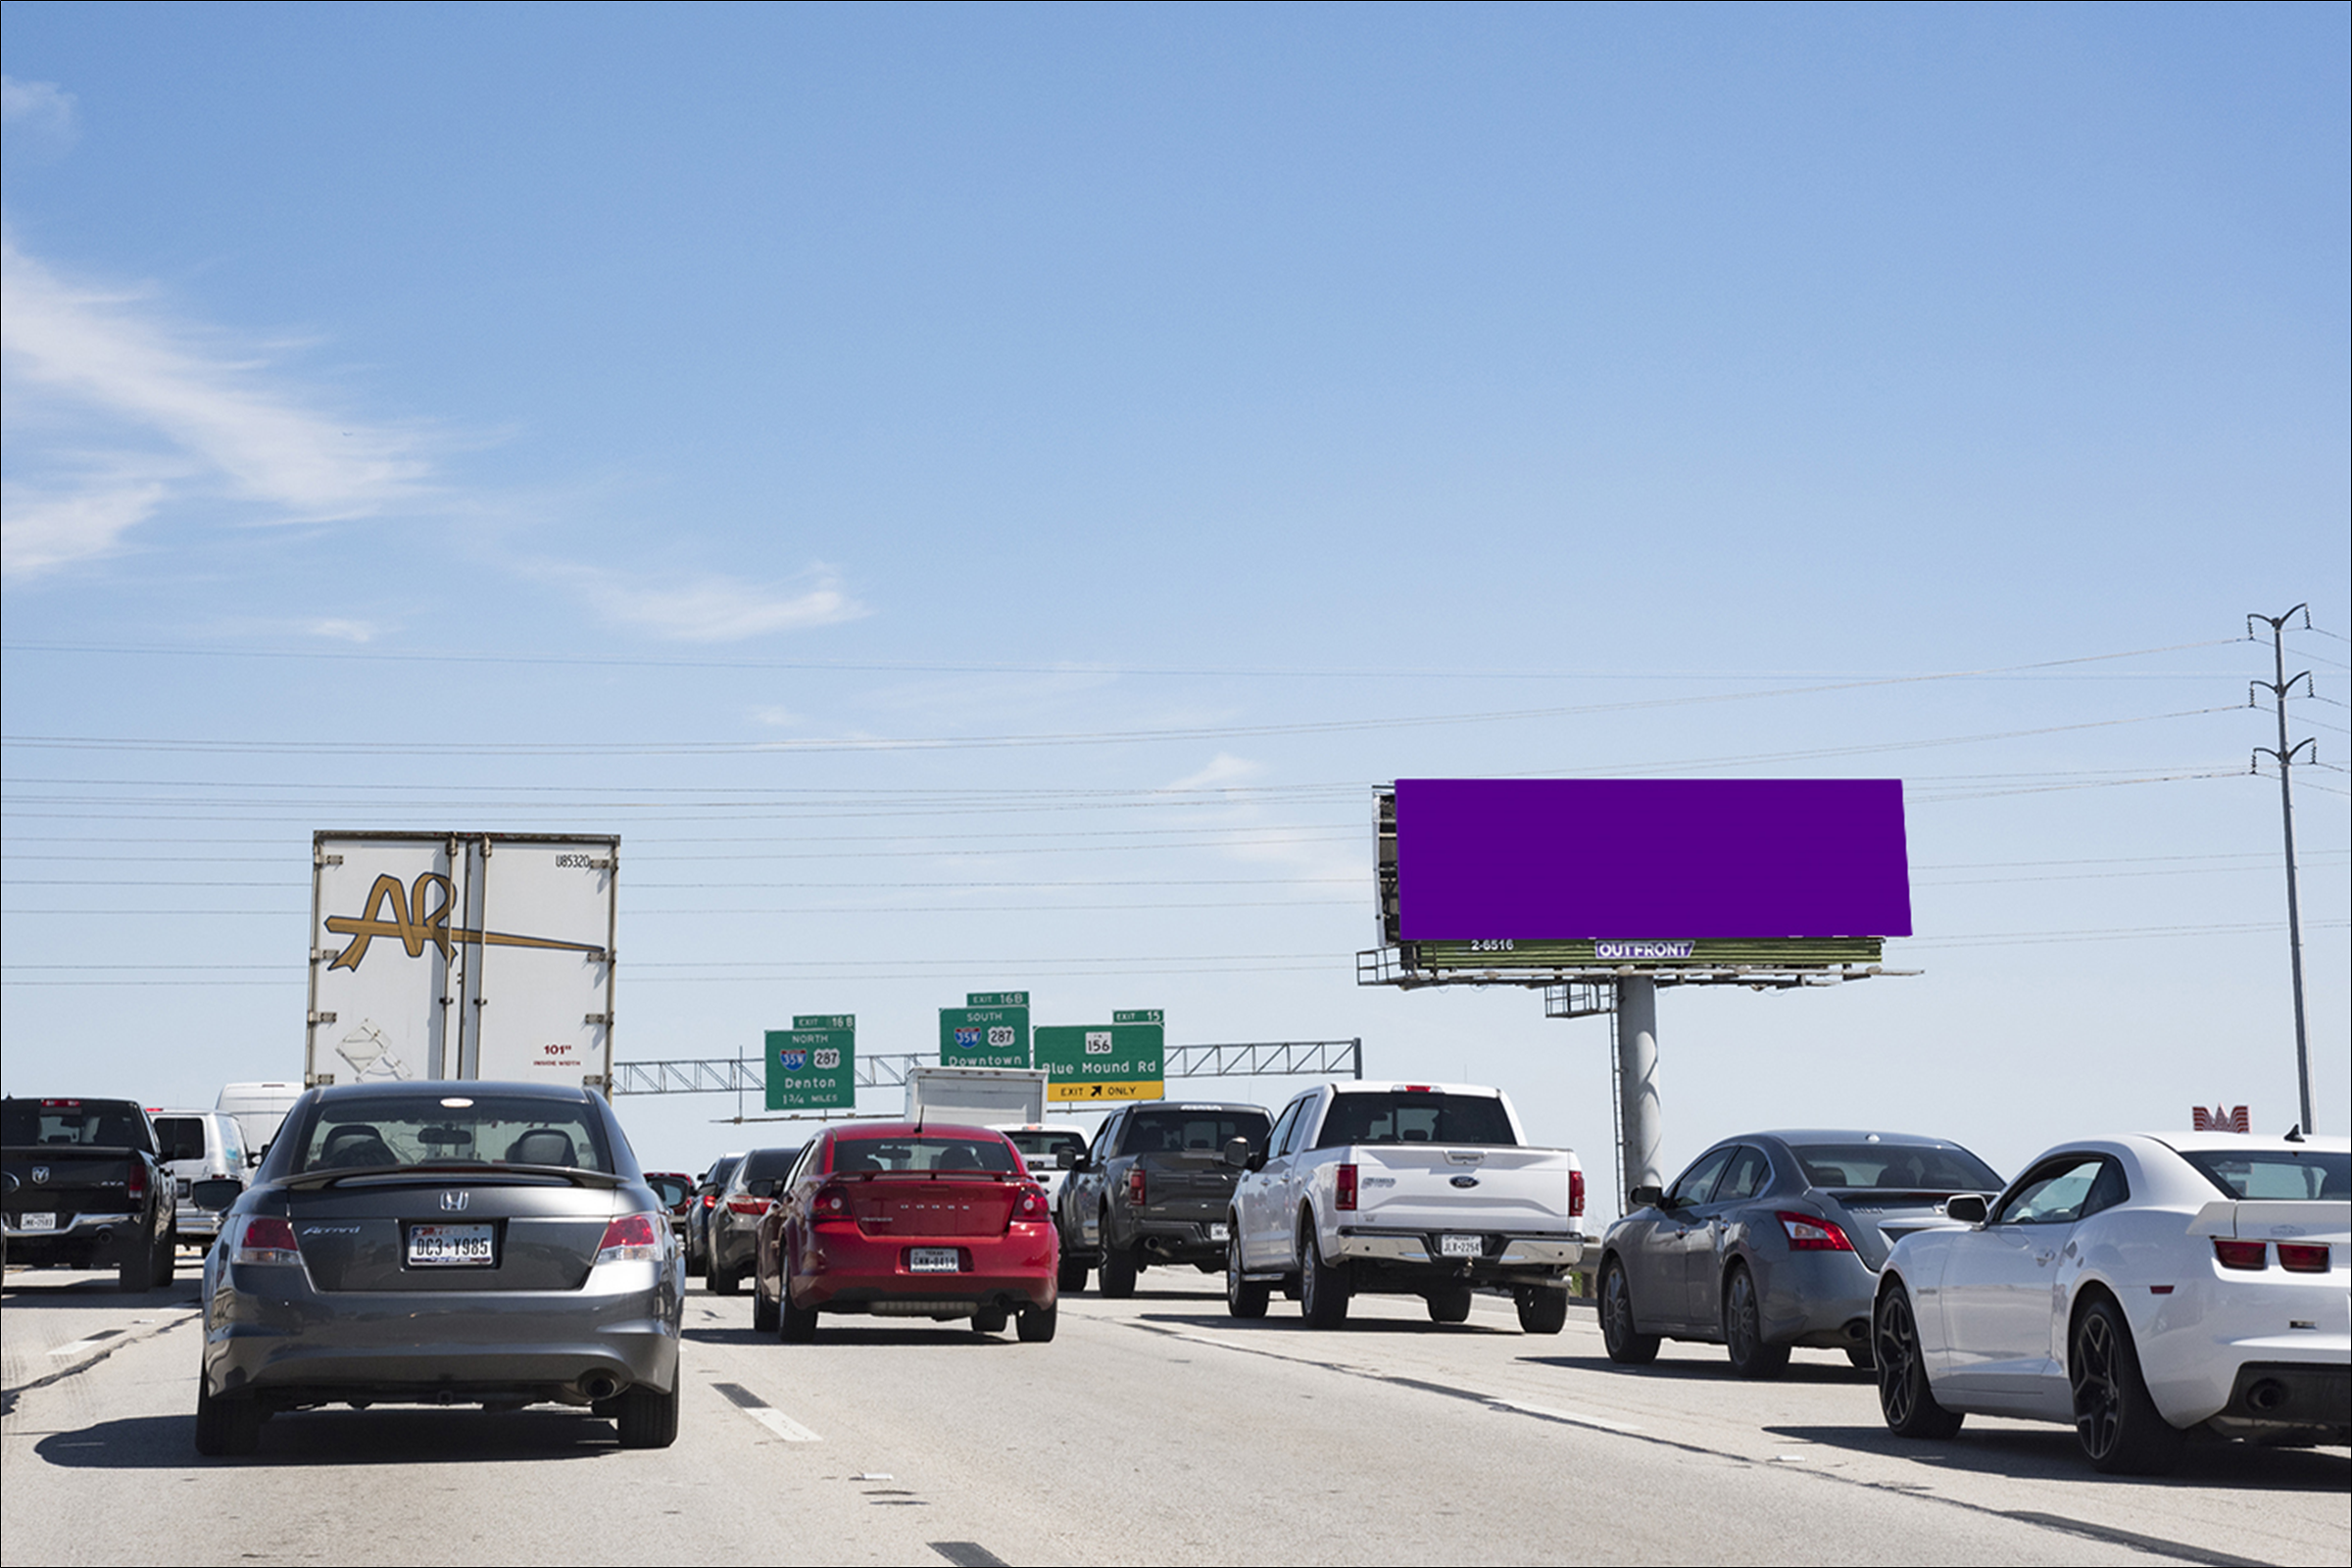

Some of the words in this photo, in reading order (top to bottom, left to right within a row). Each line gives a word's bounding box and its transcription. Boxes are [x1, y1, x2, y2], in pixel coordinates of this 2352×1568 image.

[556, 855, 589, 868] U85320
[1471, 939, 1514, 951] 2-6516
[1598, 943, 1690, 956] OUTFRONT
[973, 995, 993, 1004] EXIT
[1000, 993, 1023, 1004] 16B
[966, 1012, 1003, 1022] SOUTH
[1147, 1011, 1160, 1021] 15
[792, 1034, 829, 1044] NORTH
[990, 1030, 1012, 1043] 287
[1087, 1039, 1110, 1052] 156
[815, 1053, 838, 1065] 287
[949, 1055, 1022, 1067] Downtown
[1042, 1062, 1074, 1075] Blue
[1082, 1061, 1129, 1074] Mound
[1138, 1060, 1156, 1073] Rd
[785, 1077, 836, 1089] Denton
[1060, 1087, 1084, 1097] EXIT
[1107, 1086, 1137, 1096] ONLY
[811, 1094, 838, 1102] MILES
